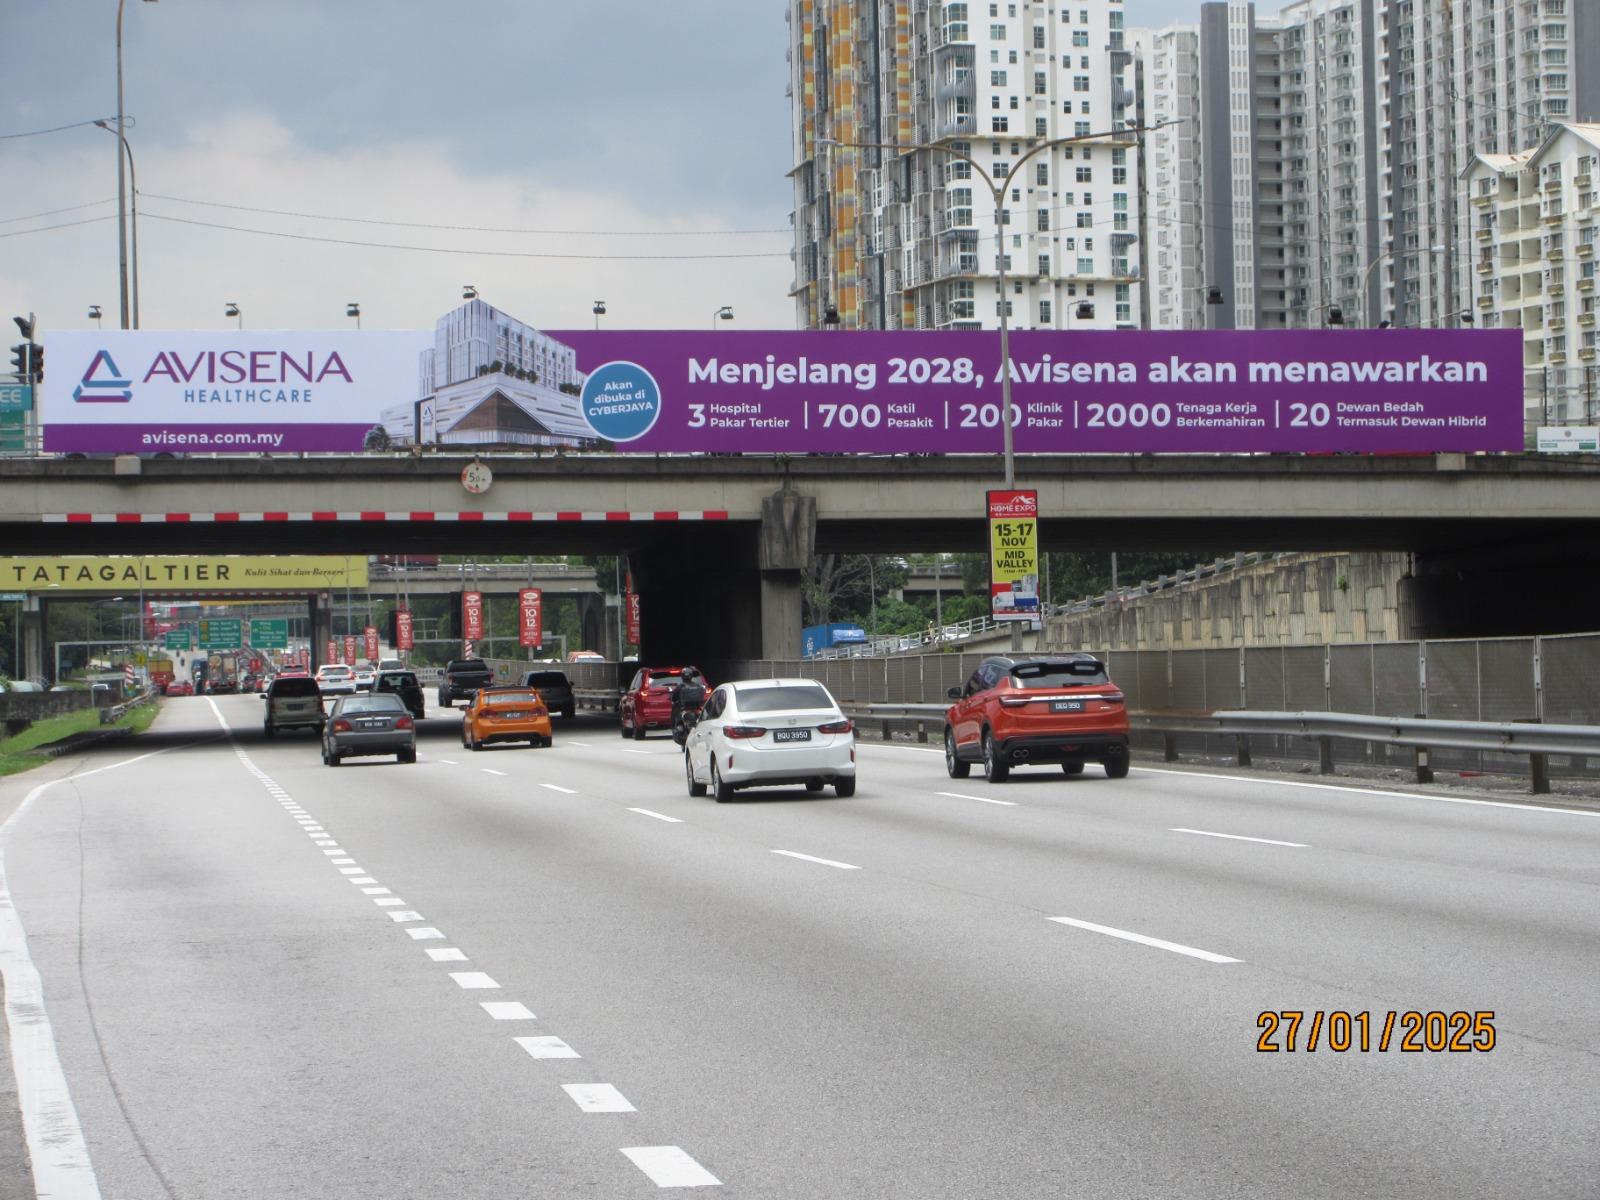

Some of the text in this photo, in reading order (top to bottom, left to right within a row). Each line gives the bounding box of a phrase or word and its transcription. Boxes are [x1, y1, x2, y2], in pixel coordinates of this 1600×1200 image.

[143, 351, 353, 383] AVISENA
[688, 354, 1488, 391] Menjelang 2028, Avisena akan menawarkan
[604, 381, 633, 391] Akan
[184, 389, 312, 403] HEALTHCARE
[594, 389, 645, 404] dibuka di
[588, 401, 654, 416] CYBERJAYA
[710, 402, 761, 416] Hospital
[887, 402, 915, 414] Katil
[1027, 402, 1063, 413] Klinik
[1176, 402, 1257, 415] Tenaga Kerja
[1337, 401, 1424, 413] Dewan Bedah
[687, 403, 706, 428] 3
[818, 403, 881, 428] 700
[959, 403, 1022, 428] 200
[1086, 402, 1171, 427] 2000
[1289, 402, 1331, 427] 20
[710, 416, 790, 428] Pakar Tertier
[887, 416, 934, 428] Pesakit
[1027, 416, 1064, 427] Pakar
[1176, 415, 1265, 427] Berkemahiran
[1337, 415, 1487, 427] Termasuk Dewan Hibrid
[142, 430, 284, 447] avisena.com.my
[995, 523, 1034, 537] 15-17
[1001, 537, 1027, 546] NOV
[1004, 550, 1025, 559] MID
[996, 559, 1034, 569] VALLEY
[12, 564, 230, 582] TATAGALTIER
[244, 568, 267, 577] Kulit
[269, 568, 291, 577] Sihat
[293, 567, 311, 577] dan
[468, 608, 479, 616] 10
[524, 608, 537, 617] 10
[469, 616, 478, 625] 12
[526, 618, 536, 628] 12
[791, 731, 808, 739] 3950
